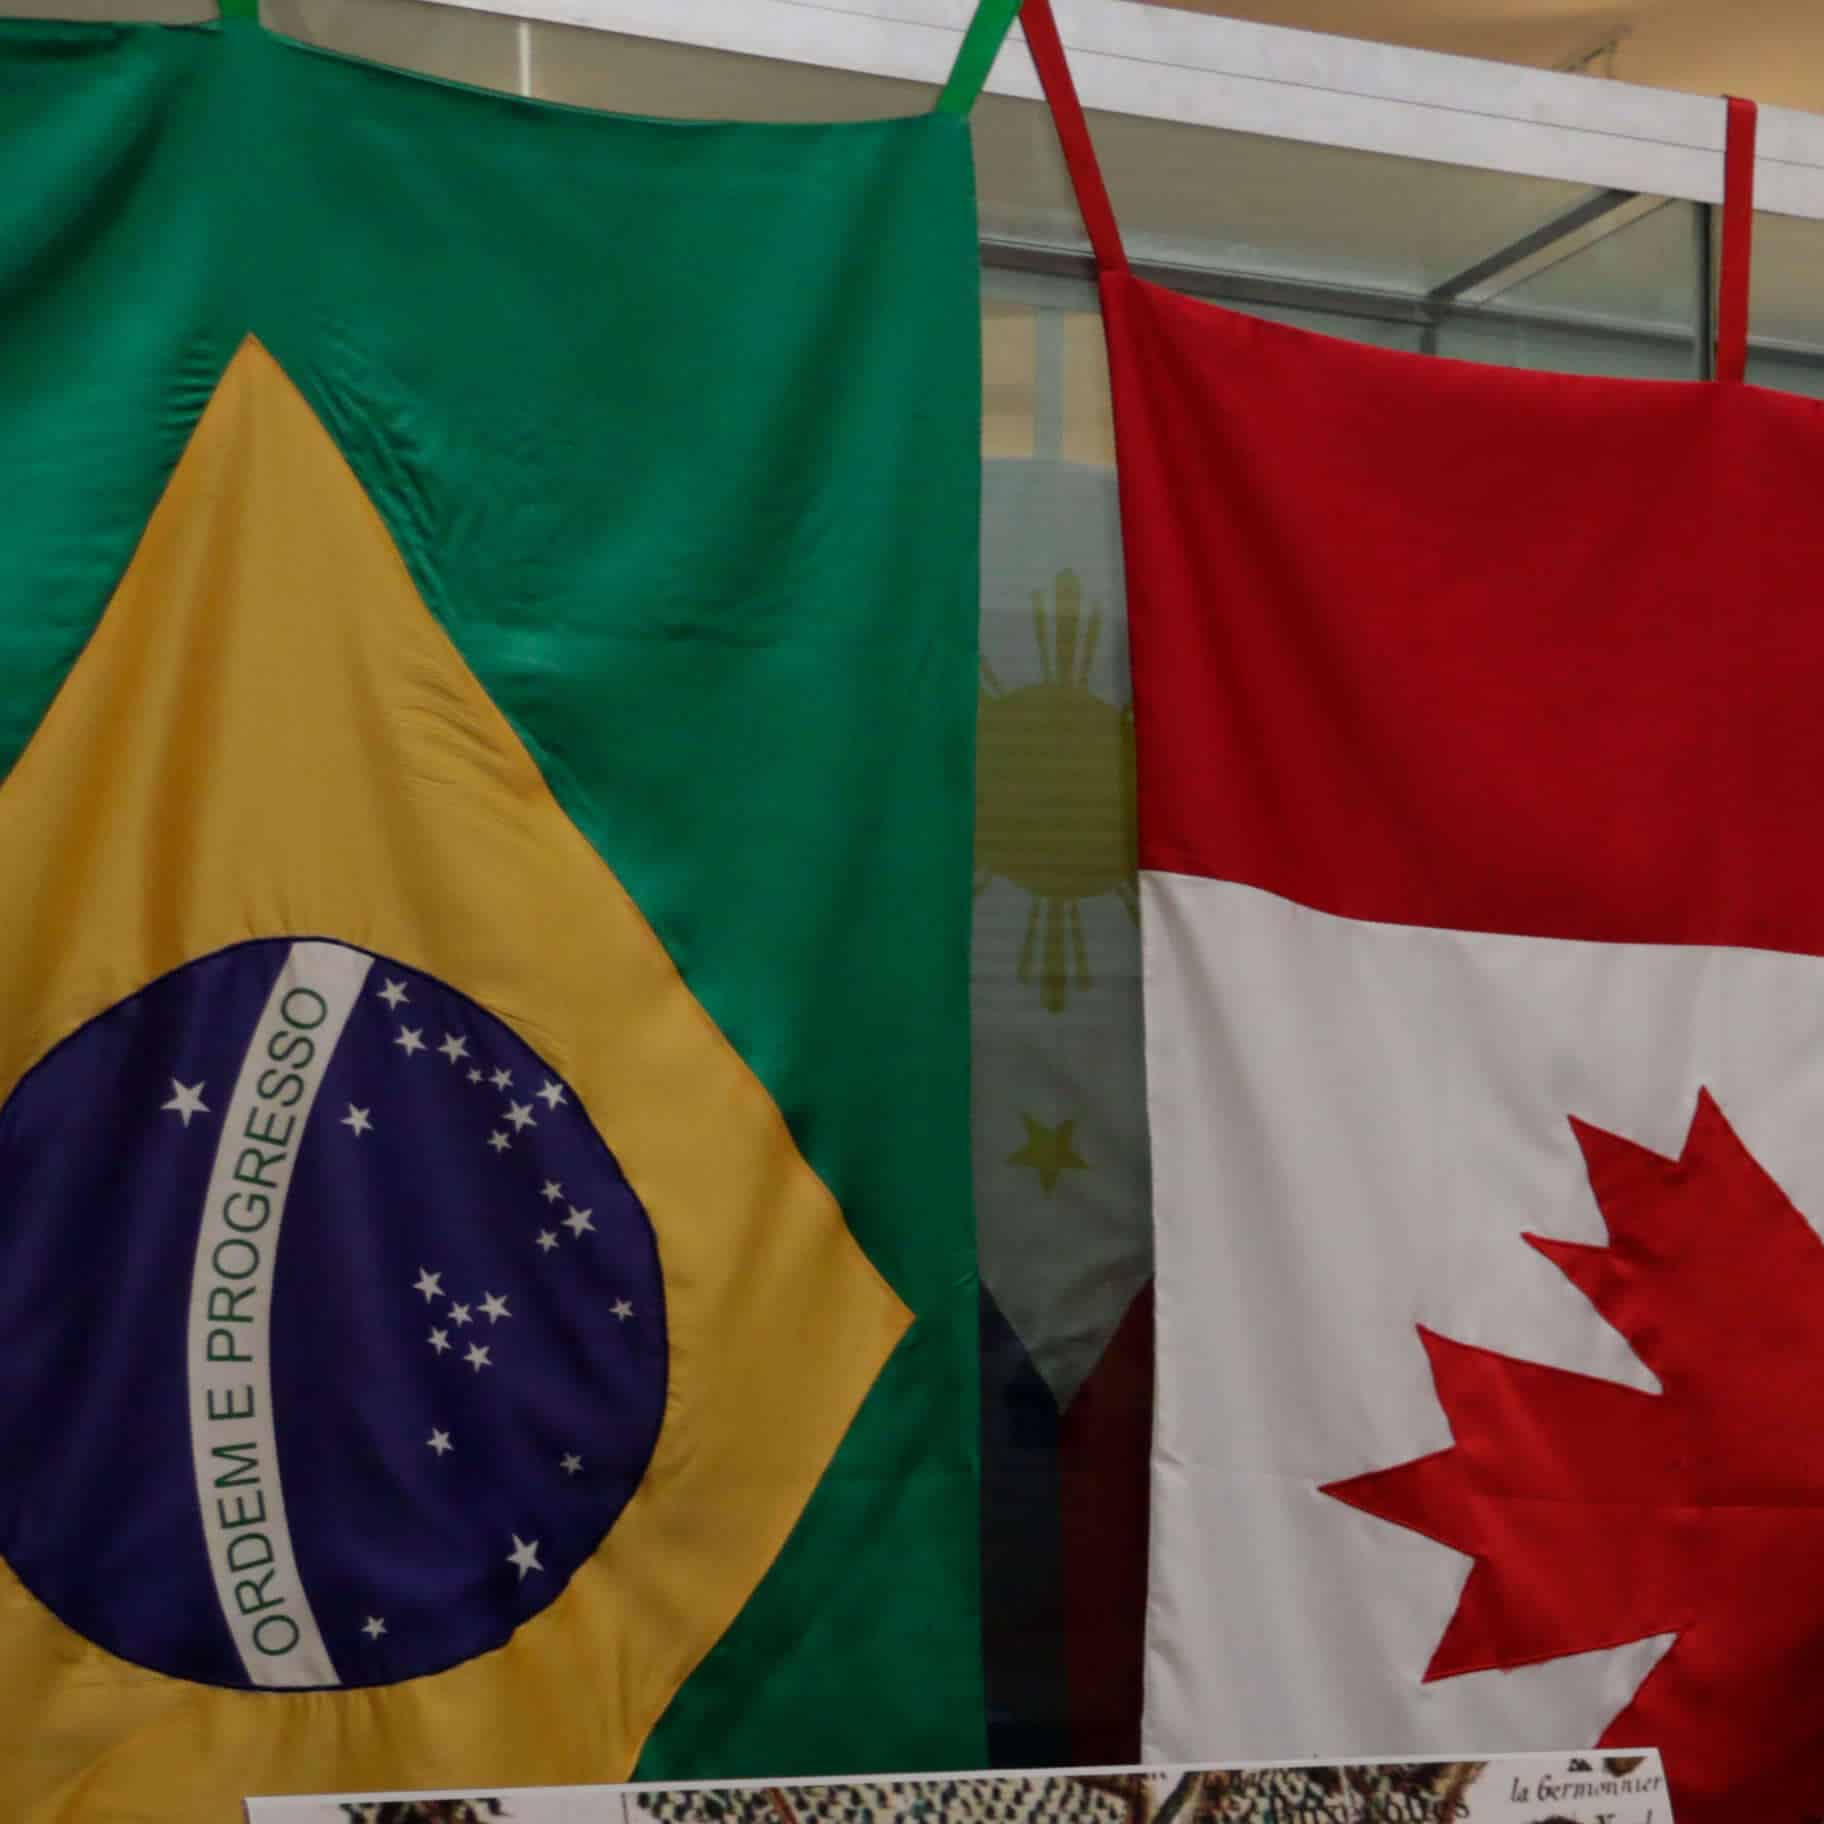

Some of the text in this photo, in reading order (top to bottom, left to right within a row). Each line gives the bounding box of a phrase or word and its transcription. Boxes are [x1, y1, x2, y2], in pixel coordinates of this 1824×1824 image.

[207, 986, 328, 1657] ORDEM E PROGRESSO
